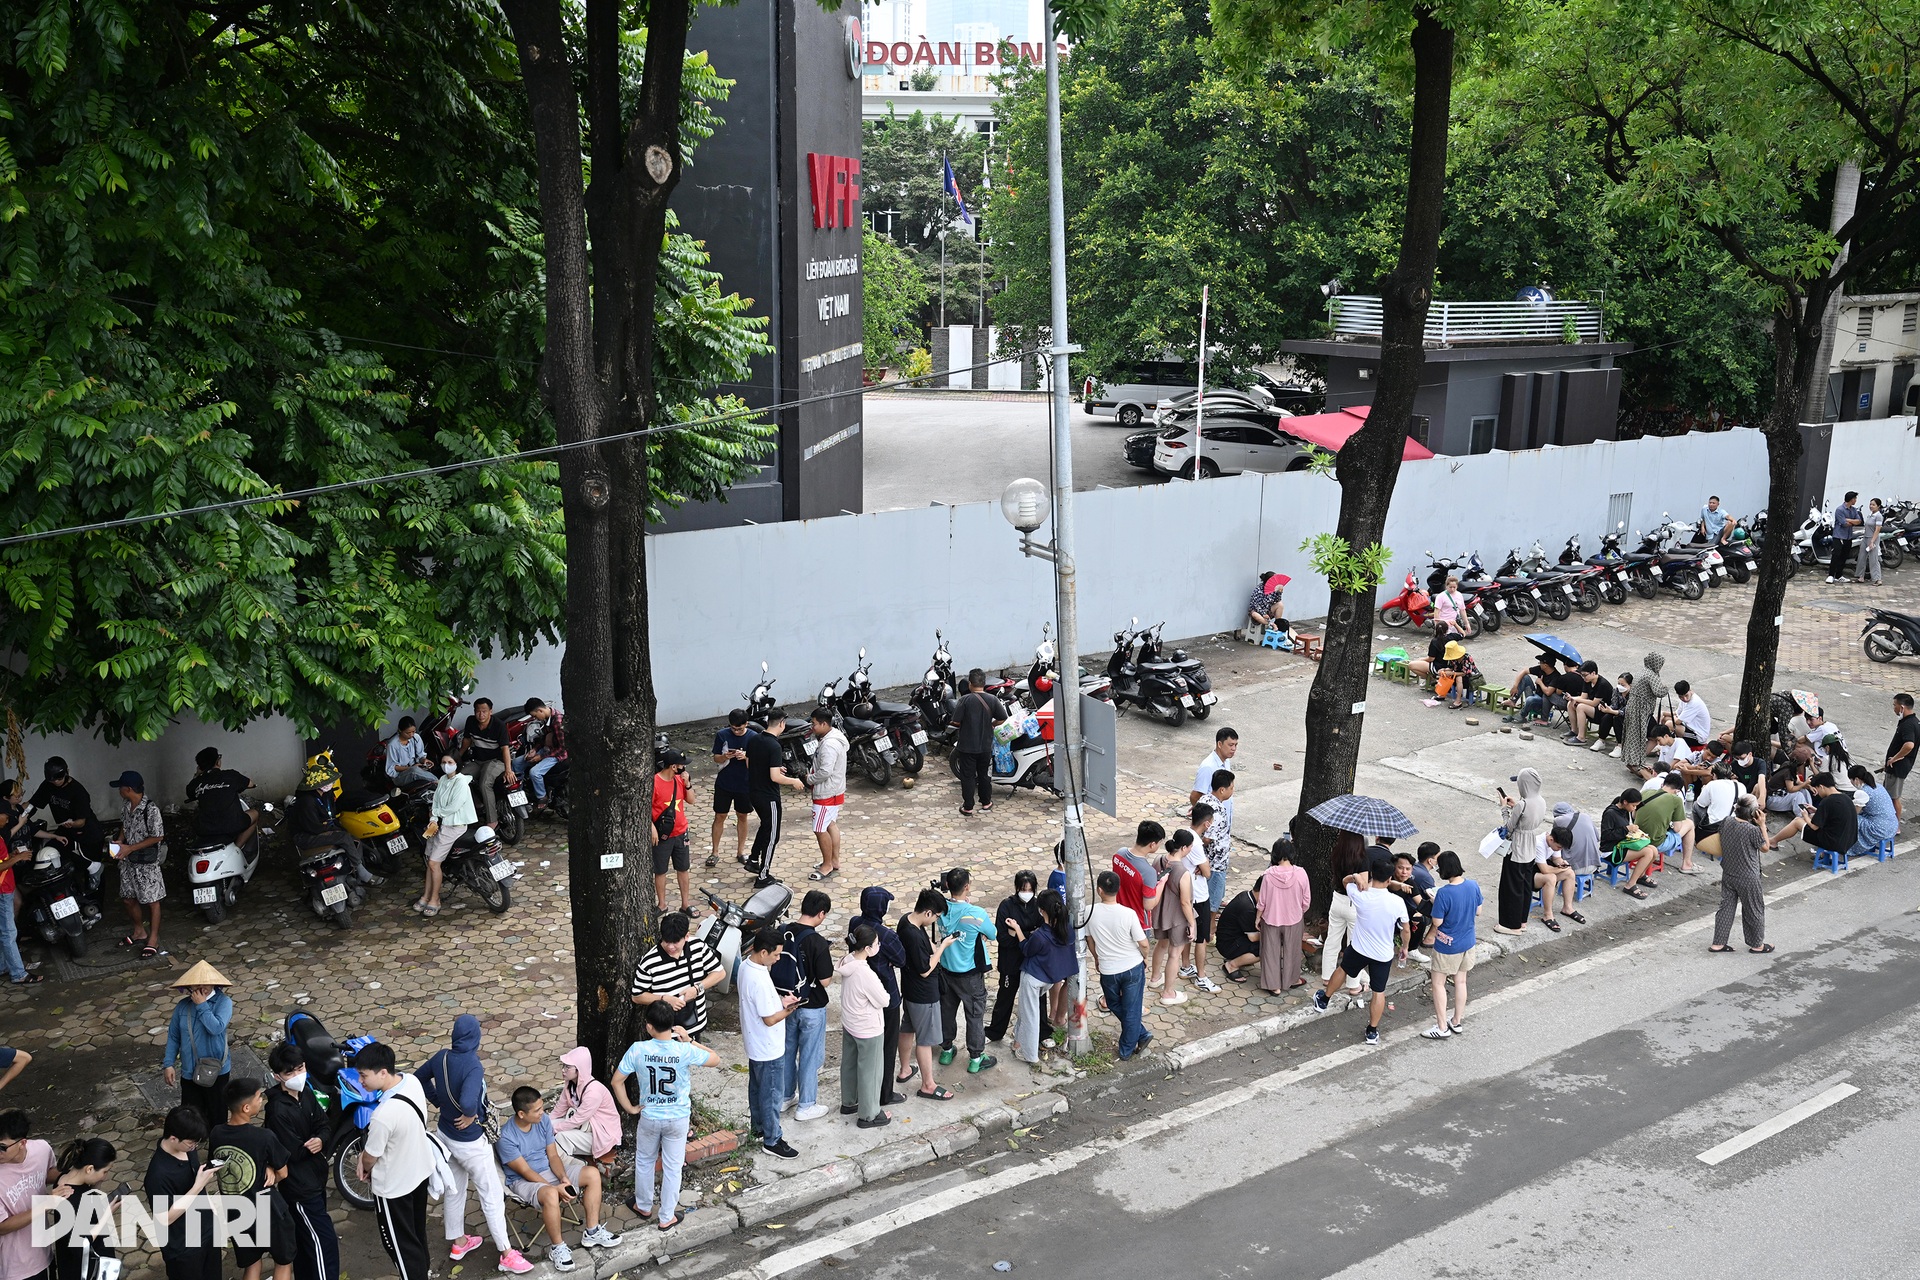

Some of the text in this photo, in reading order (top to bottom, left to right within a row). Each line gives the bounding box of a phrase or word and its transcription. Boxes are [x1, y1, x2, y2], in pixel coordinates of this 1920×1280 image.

[865, 35, 960, 65] ĐOÀN
[807, 152, 860, 228] VFF
[604, 855, 620, 864] 127
[646, 1066, 676, 1095] 12
